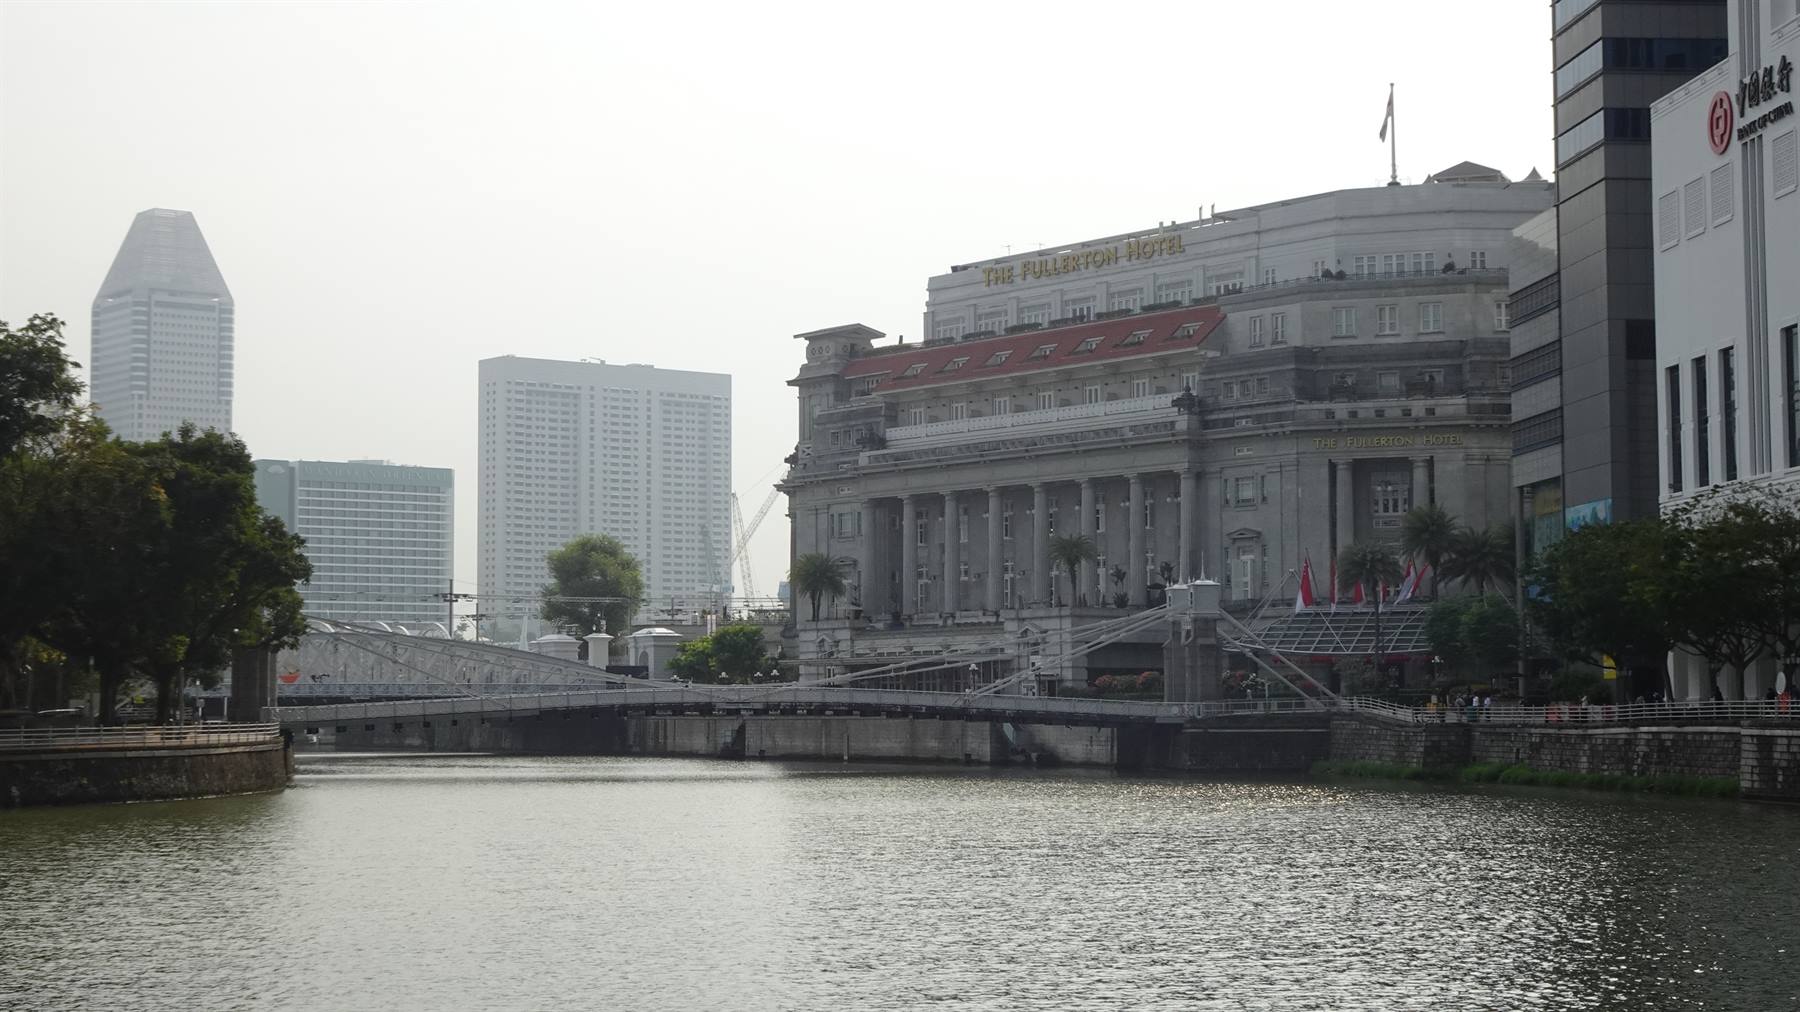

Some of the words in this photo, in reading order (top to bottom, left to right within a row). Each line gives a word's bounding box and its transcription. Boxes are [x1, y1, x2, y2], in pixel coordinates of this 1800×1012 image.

[1737, 119, 1758, 141] BANK
[1757, 113, 1768, 130] OF
[1768, 101, 1794, 123] CHINA
[982, 264, 1014, 287] THE
[1020, 247, 1118, 280] FULLERTON
[1127, 234, 1185, 262] HOTEL
[1313, 438, 1337, 449] THE
[1346, 436, 1414, 448] FULLERTON
[1423, 434, 1465, 446] HOTEL
